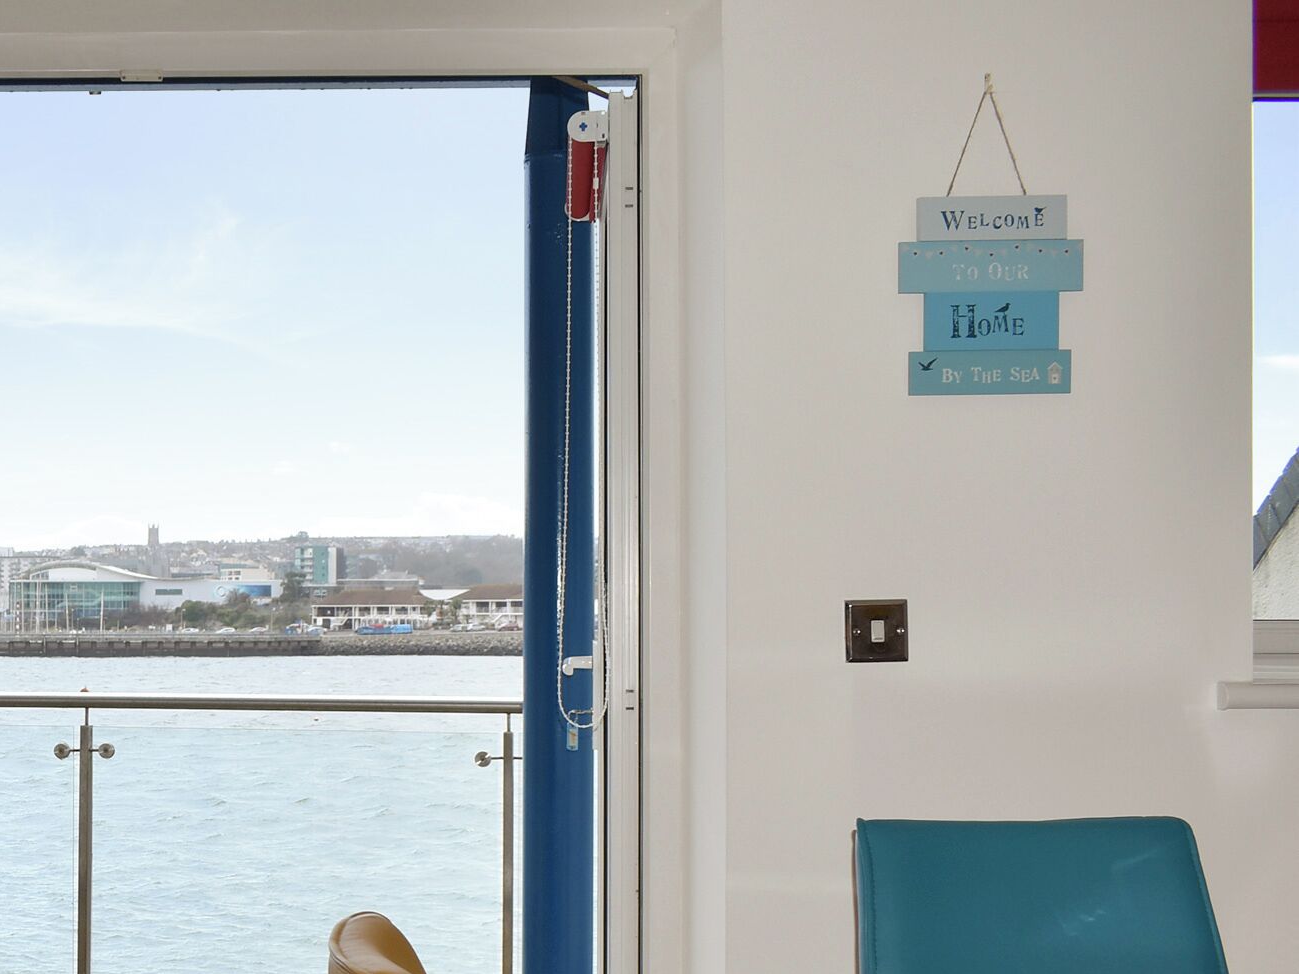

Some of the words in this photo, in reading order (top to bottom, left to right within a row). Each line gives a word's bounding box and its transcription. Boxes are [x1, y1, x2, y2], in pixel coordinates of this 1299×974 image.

[940, 209, 1045, 231] WELCOME
[952, 264, 978, 281] TO
[988, 262, 1029, 281] OUR
[950, 304, 1025, 339] HOME
[942, 368, 962, 384] BY
[971, 367, 1001, 382] THE
[1010, 367, 1040, 382] SEA
